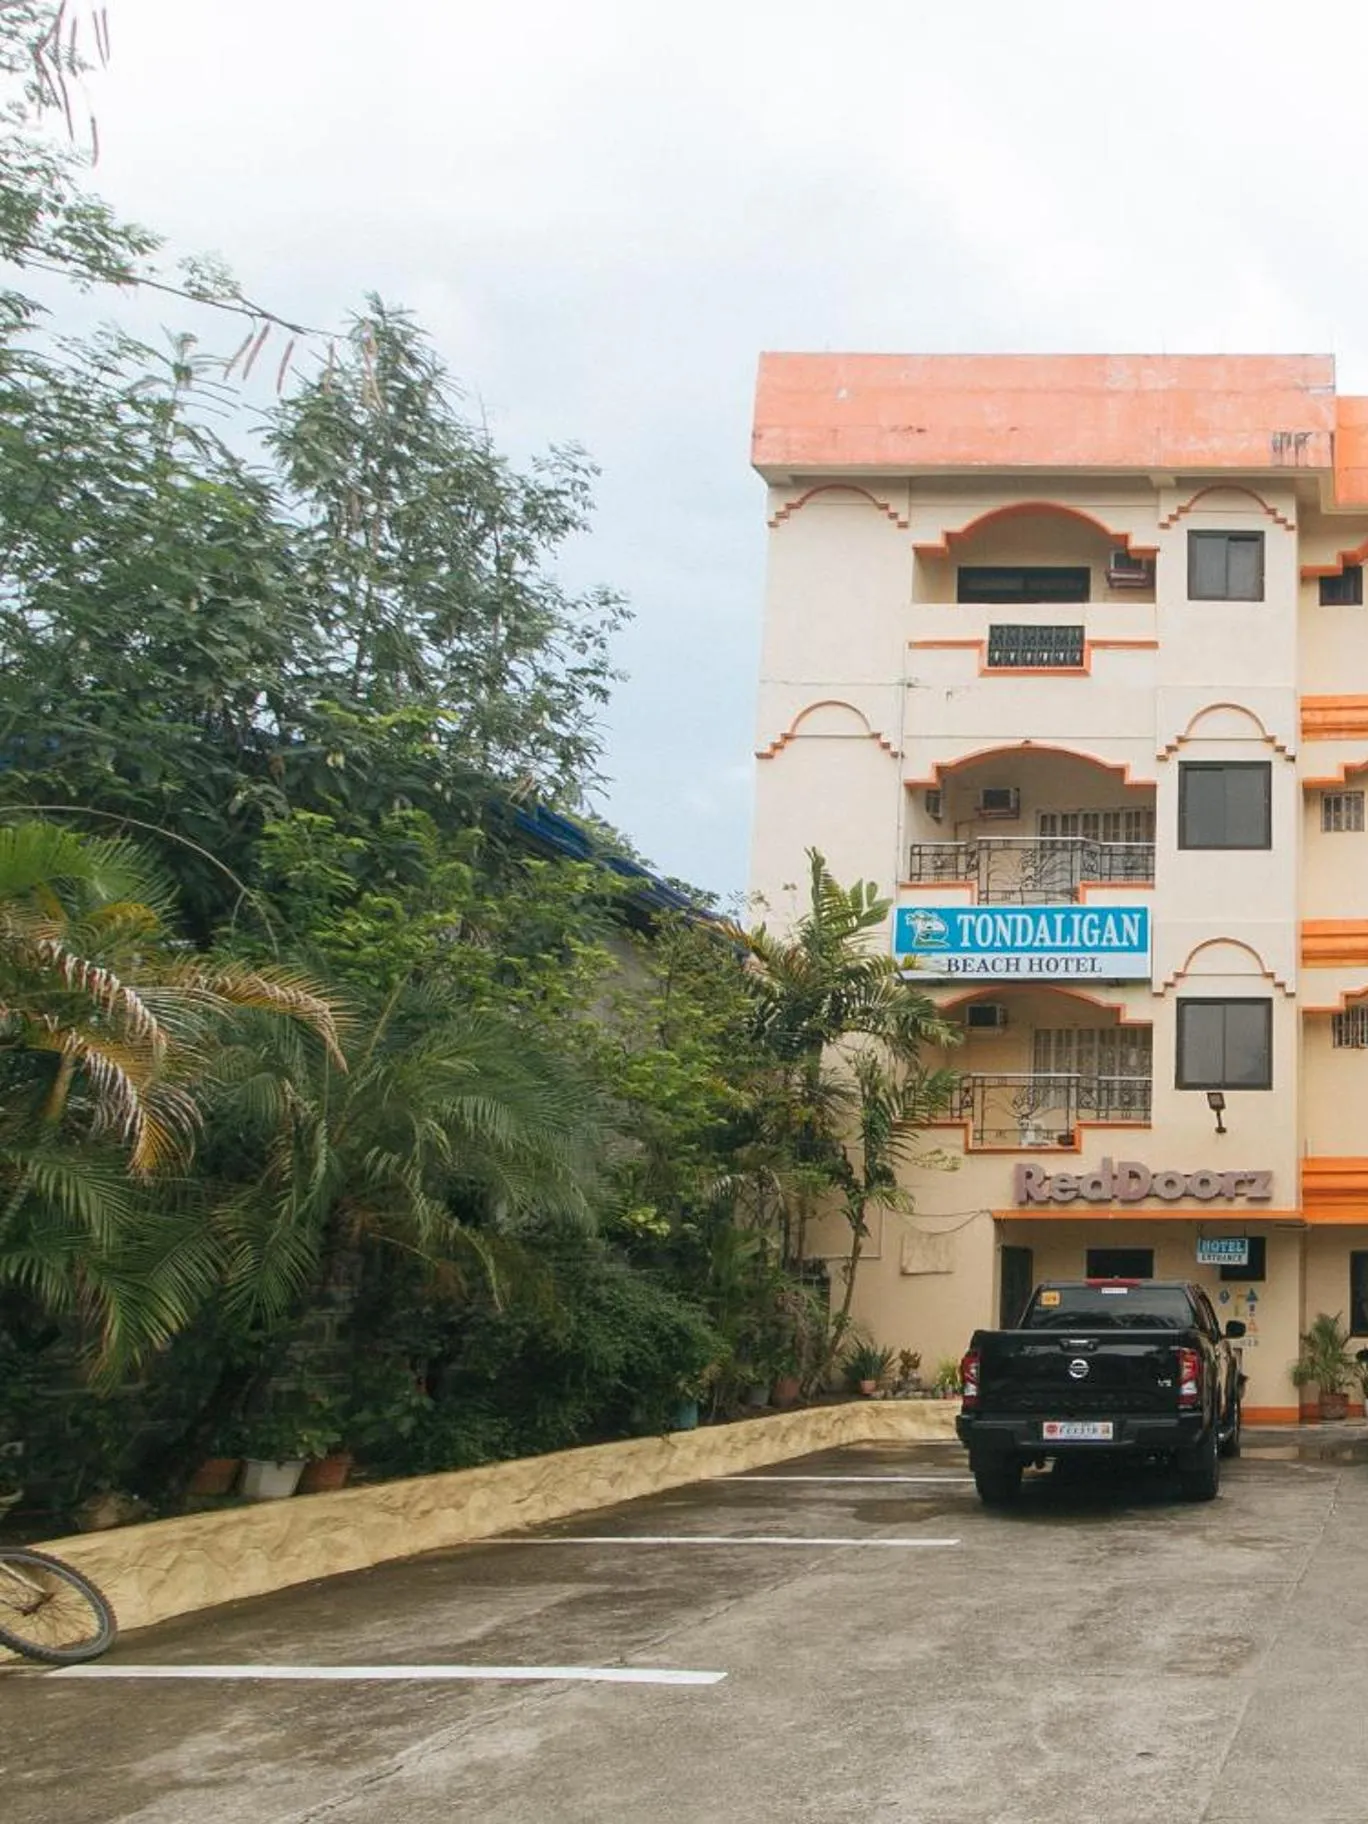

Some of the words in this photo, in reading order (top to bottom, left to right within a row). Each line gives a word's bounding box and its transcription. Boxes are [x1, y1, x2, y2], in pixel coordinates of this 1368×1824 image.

[957, 913, 1141, 948] TONDALIGAN
[947, 957, 1020, 973] BEACH
[1028, 957, 1103, 973] HOTEL
[1014, 1157, 1273, 1206] RedDoorz
[1201, 1239, 1245, 1252] HOTEL
